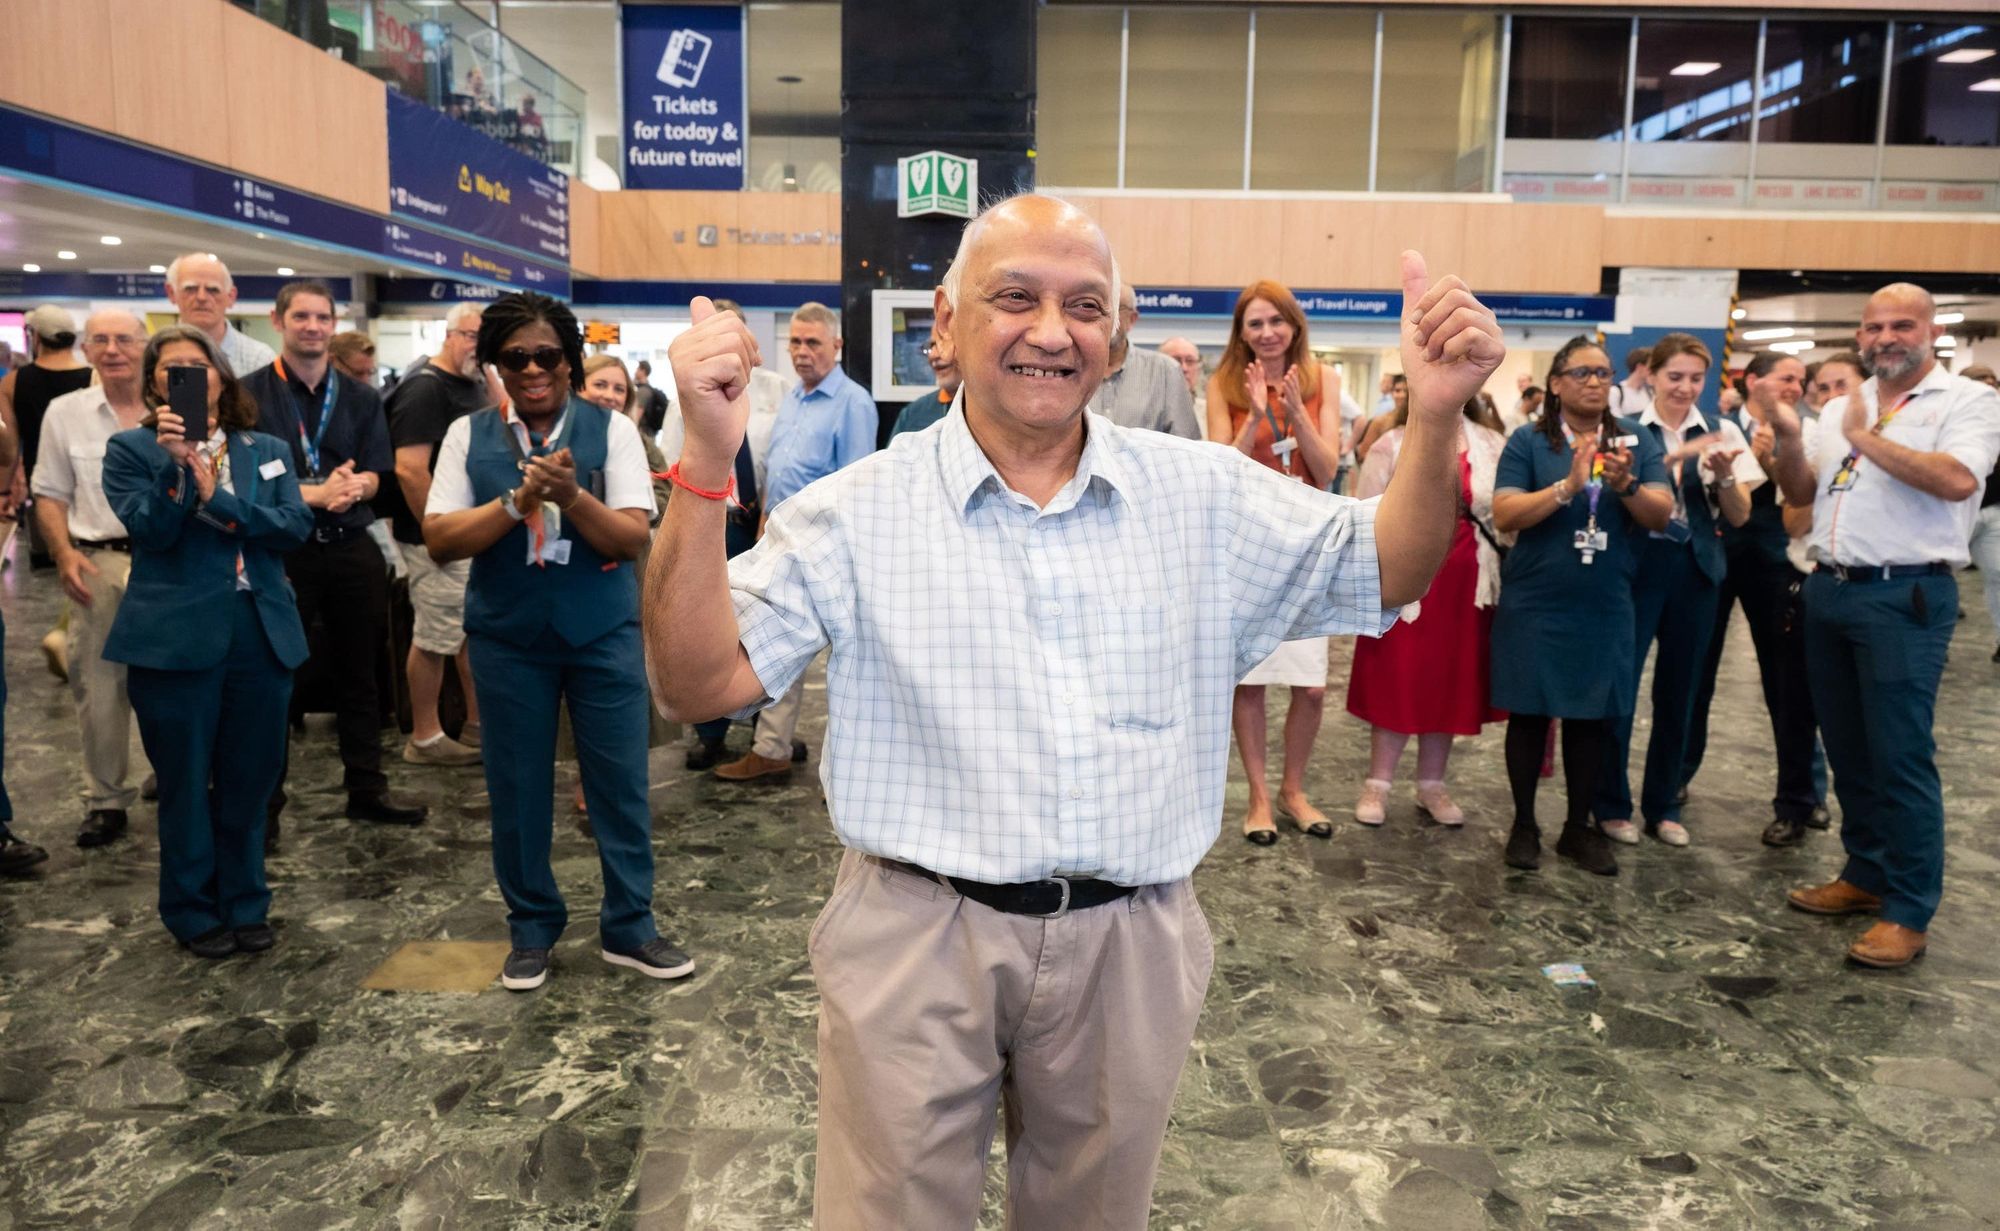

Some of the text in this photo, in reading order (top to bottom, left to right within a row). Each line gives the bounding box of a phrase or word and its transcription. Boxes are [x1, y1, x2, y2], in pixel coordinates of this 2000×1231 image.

[651, 95, 718, 115] Tickets
[633, 120, 738, 145] for today &
[629, 146, 742, 167] future travel
[475, 173, 494, 201] Way
[494, 181, 511, 205] Out
[453, 284, 499, 298] Tickets
[1135, 293, 1193, 308] cket office
[1315, 298, 1347, 311] Travel
[1348, 299, 1388, 314] Lounge
